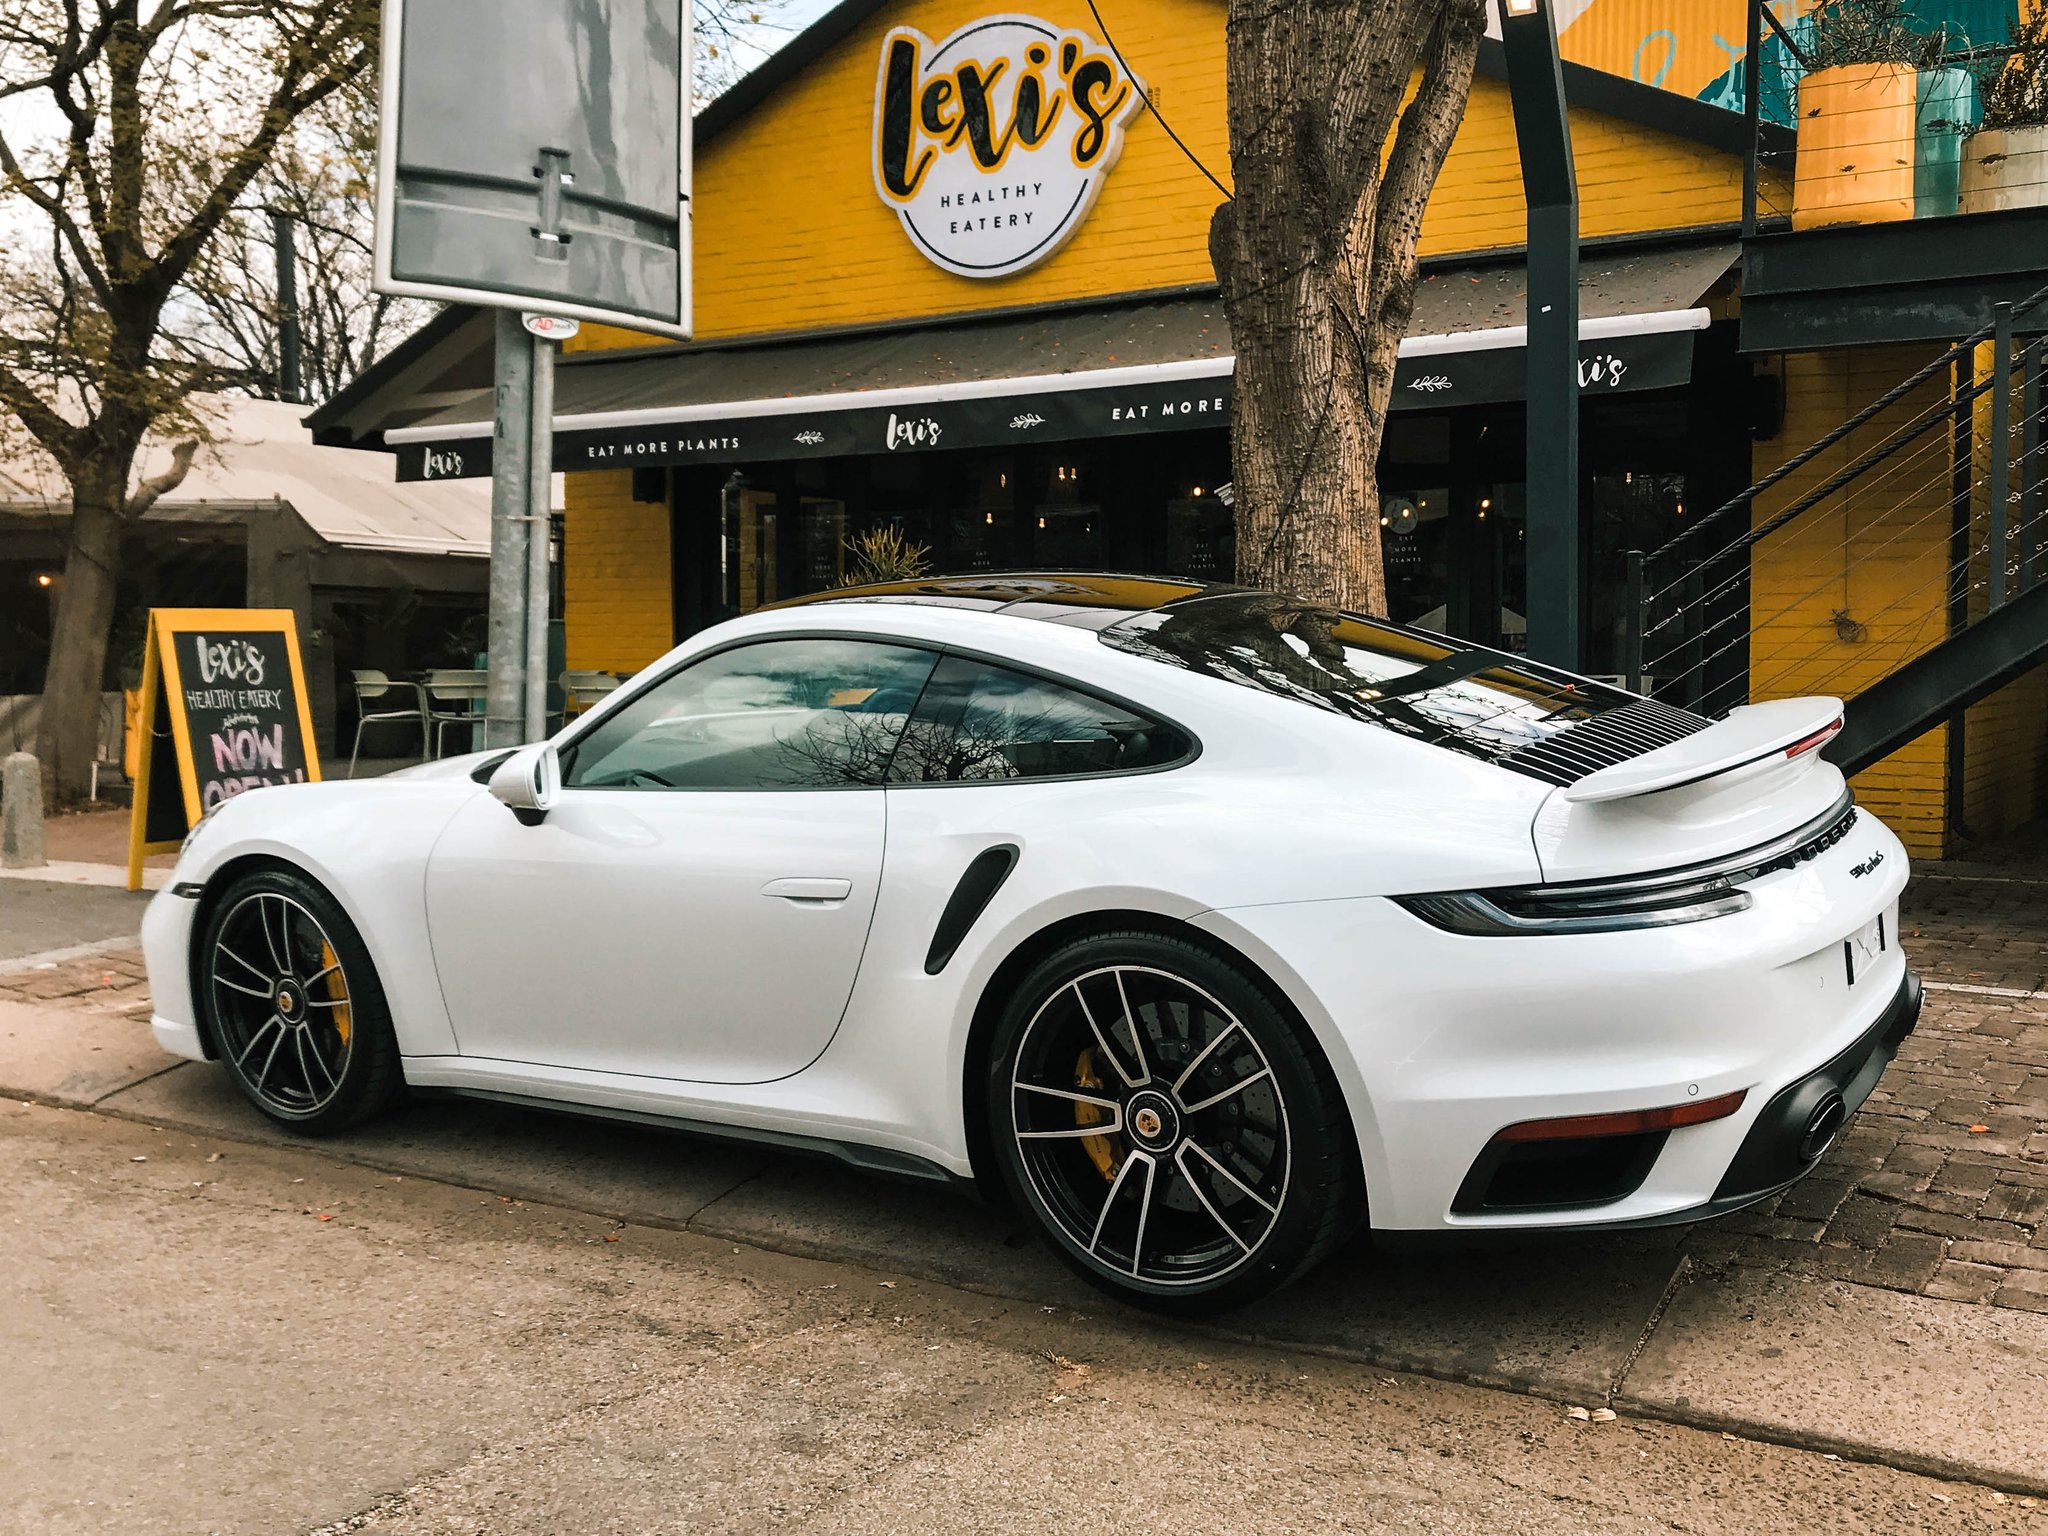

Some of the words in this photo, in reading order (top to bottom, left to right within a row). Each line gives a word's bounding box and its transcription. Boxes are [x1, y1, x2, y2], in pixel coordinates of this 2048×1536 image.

[941, 182, 1043, 208] HEALTHY
[950, 212, 1033, 234] EATERY
[1112, 405, 1149, 421] EAT
[1162, 398, 1224, 416] MORE
[588, 445, 616, 458] EAT
[623, 440, 669, 455] MORE
[677, 437, 740, 452] PLANTS
[187, 690, 236, 710] HEALTHY
[239, 689, 281, 710] EATERY
[210, 723, 284, 773] NOW
